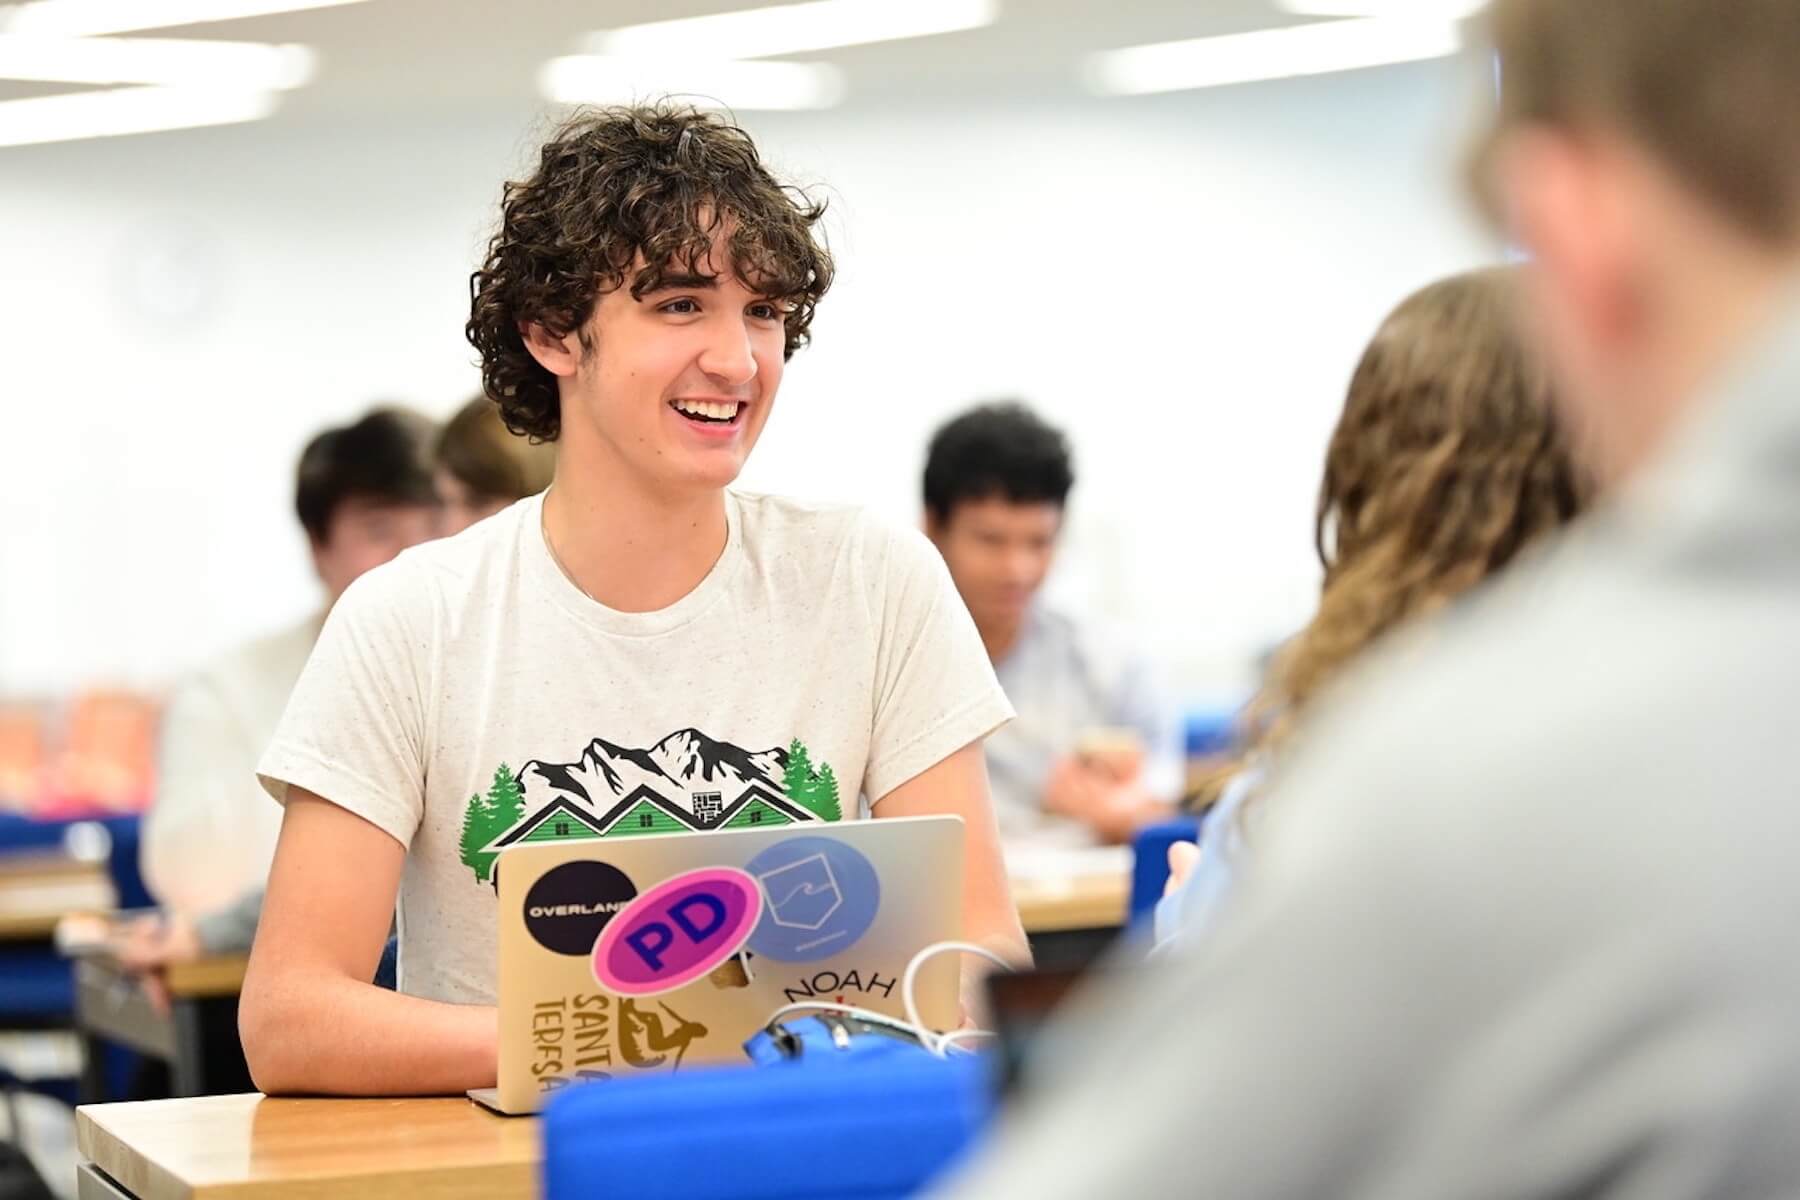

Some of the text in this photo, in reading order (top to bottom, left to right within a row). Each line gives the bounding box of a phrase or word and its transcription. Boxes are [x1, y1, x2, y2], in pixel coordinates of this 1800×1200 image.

[625, 893, 726, 973] PD
[783, 970, 897, 1003] NOAH
[572, 994, 612, 1084] SANTA
